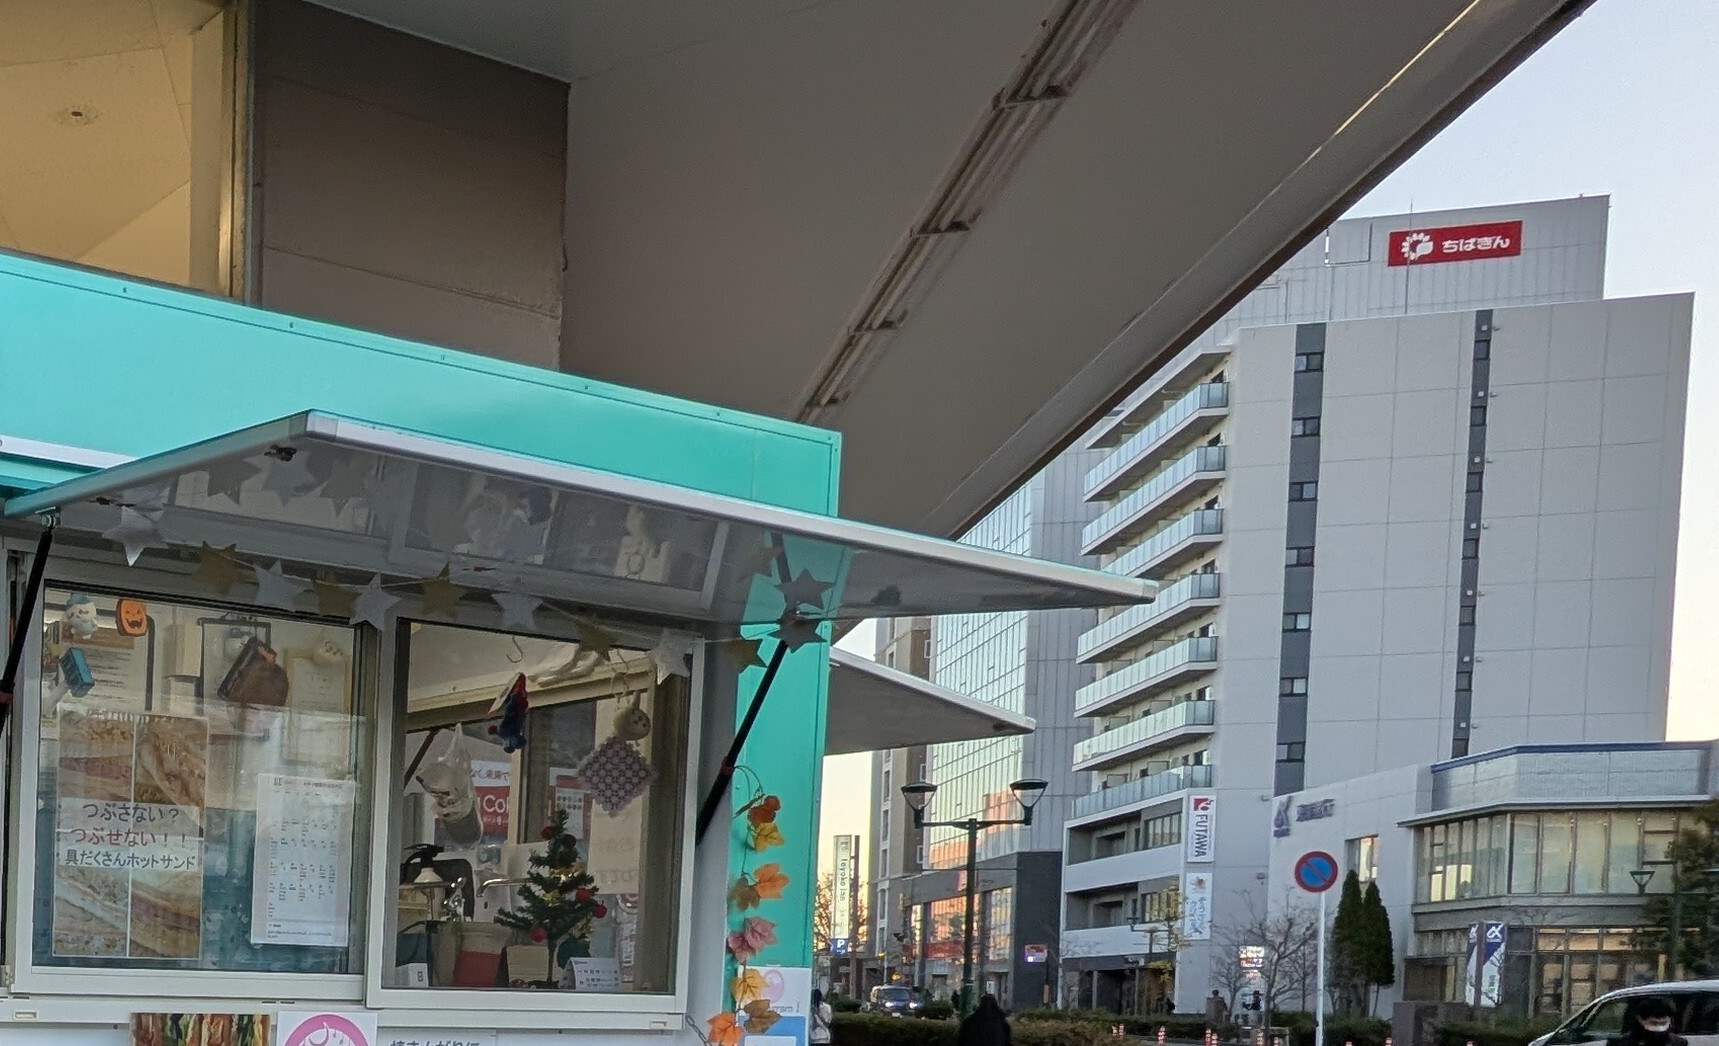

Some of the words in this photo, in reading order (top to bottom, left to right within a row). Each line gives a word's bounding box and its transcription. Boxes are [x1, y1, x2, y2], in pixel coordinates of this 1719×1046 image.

[1442, 235, 1510, 253] ちばぎん
[1194, 814, 1208, 858] FUTAWA
[65, 849, 196, 870] 具だくさんホットサンド
